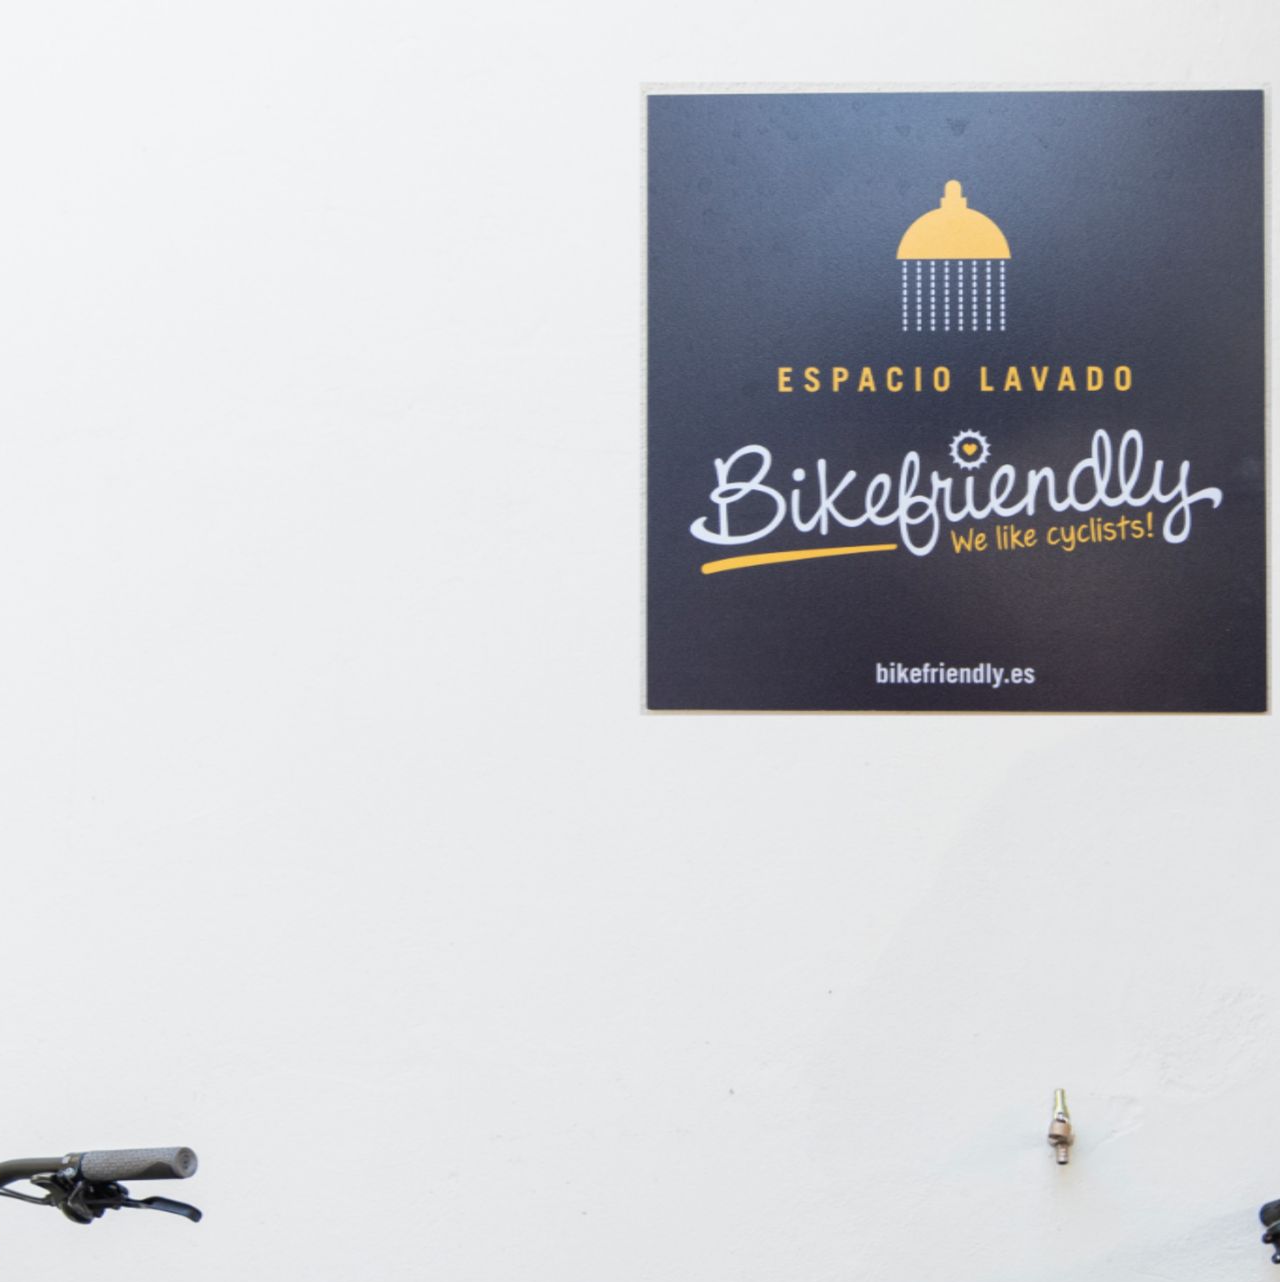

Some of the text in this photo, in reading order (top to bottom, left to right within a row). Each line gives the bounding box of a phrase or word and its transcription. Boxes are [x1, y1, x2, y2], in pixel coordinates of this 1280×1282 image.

[777, 365, 1133, 392] ESPACIO LAVADO
[689, 428, 1223, 556] Bikefriendly
[951, 511, 1154, 554] We like cyclists!
[875, 662, 1036, 689] bikefriendly.es
